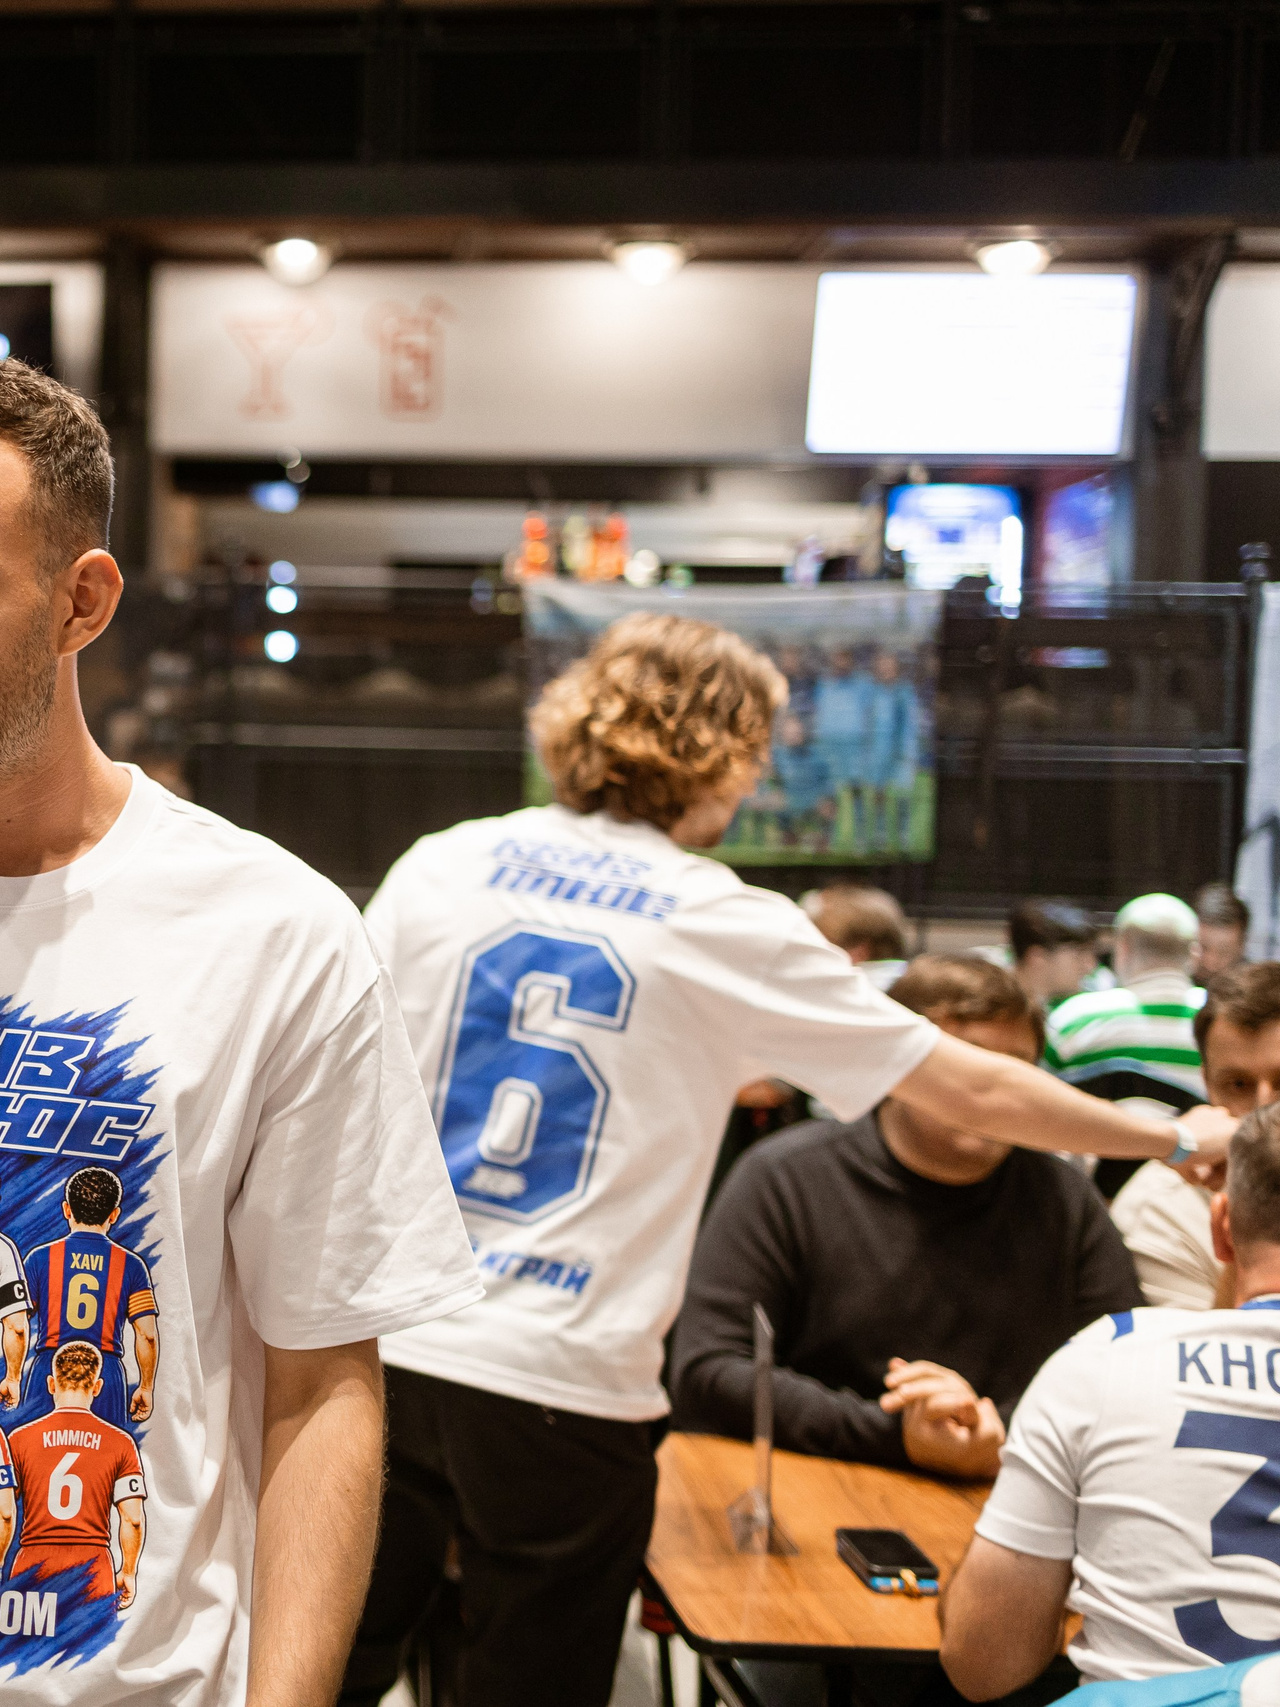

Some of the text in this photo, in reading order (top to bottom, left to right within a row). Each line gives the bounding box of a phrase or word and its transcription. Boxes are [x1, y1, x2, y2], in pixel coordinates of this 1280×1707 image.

[434, 919, 637, 1225] 6
[70, 1252, 104, 1272] XAVI
[479, 1252, 593, 1295] ИГРАЙ
[13, 1283, 25, 1300] C
[66, 1272, 100, 1330] 6
[42, 1429, 102, 1451] KIMMICH
[47, 1452, 84, 1521] 6
[129, 1478, 139, 1493] C
